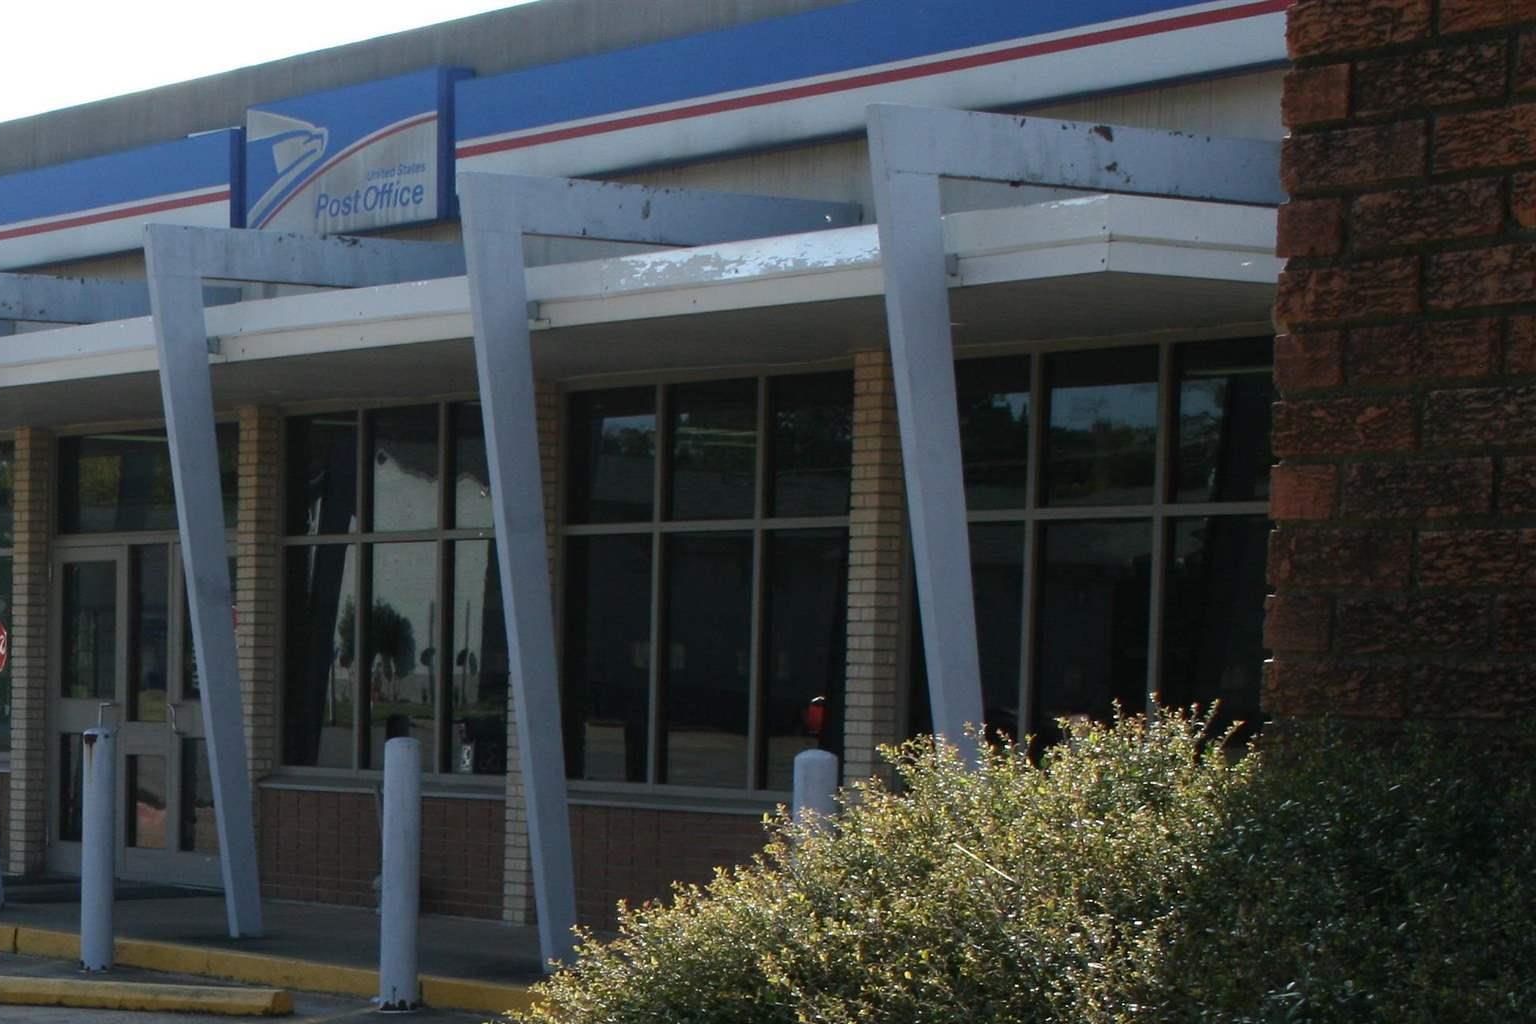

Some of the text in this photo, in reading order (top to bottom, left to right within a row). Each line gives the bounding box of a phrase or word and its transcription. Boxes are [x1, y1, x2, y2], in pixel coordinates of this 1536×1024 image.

[397, 163, 426, 177] States
[315, 181, 424, 219] Post Office
